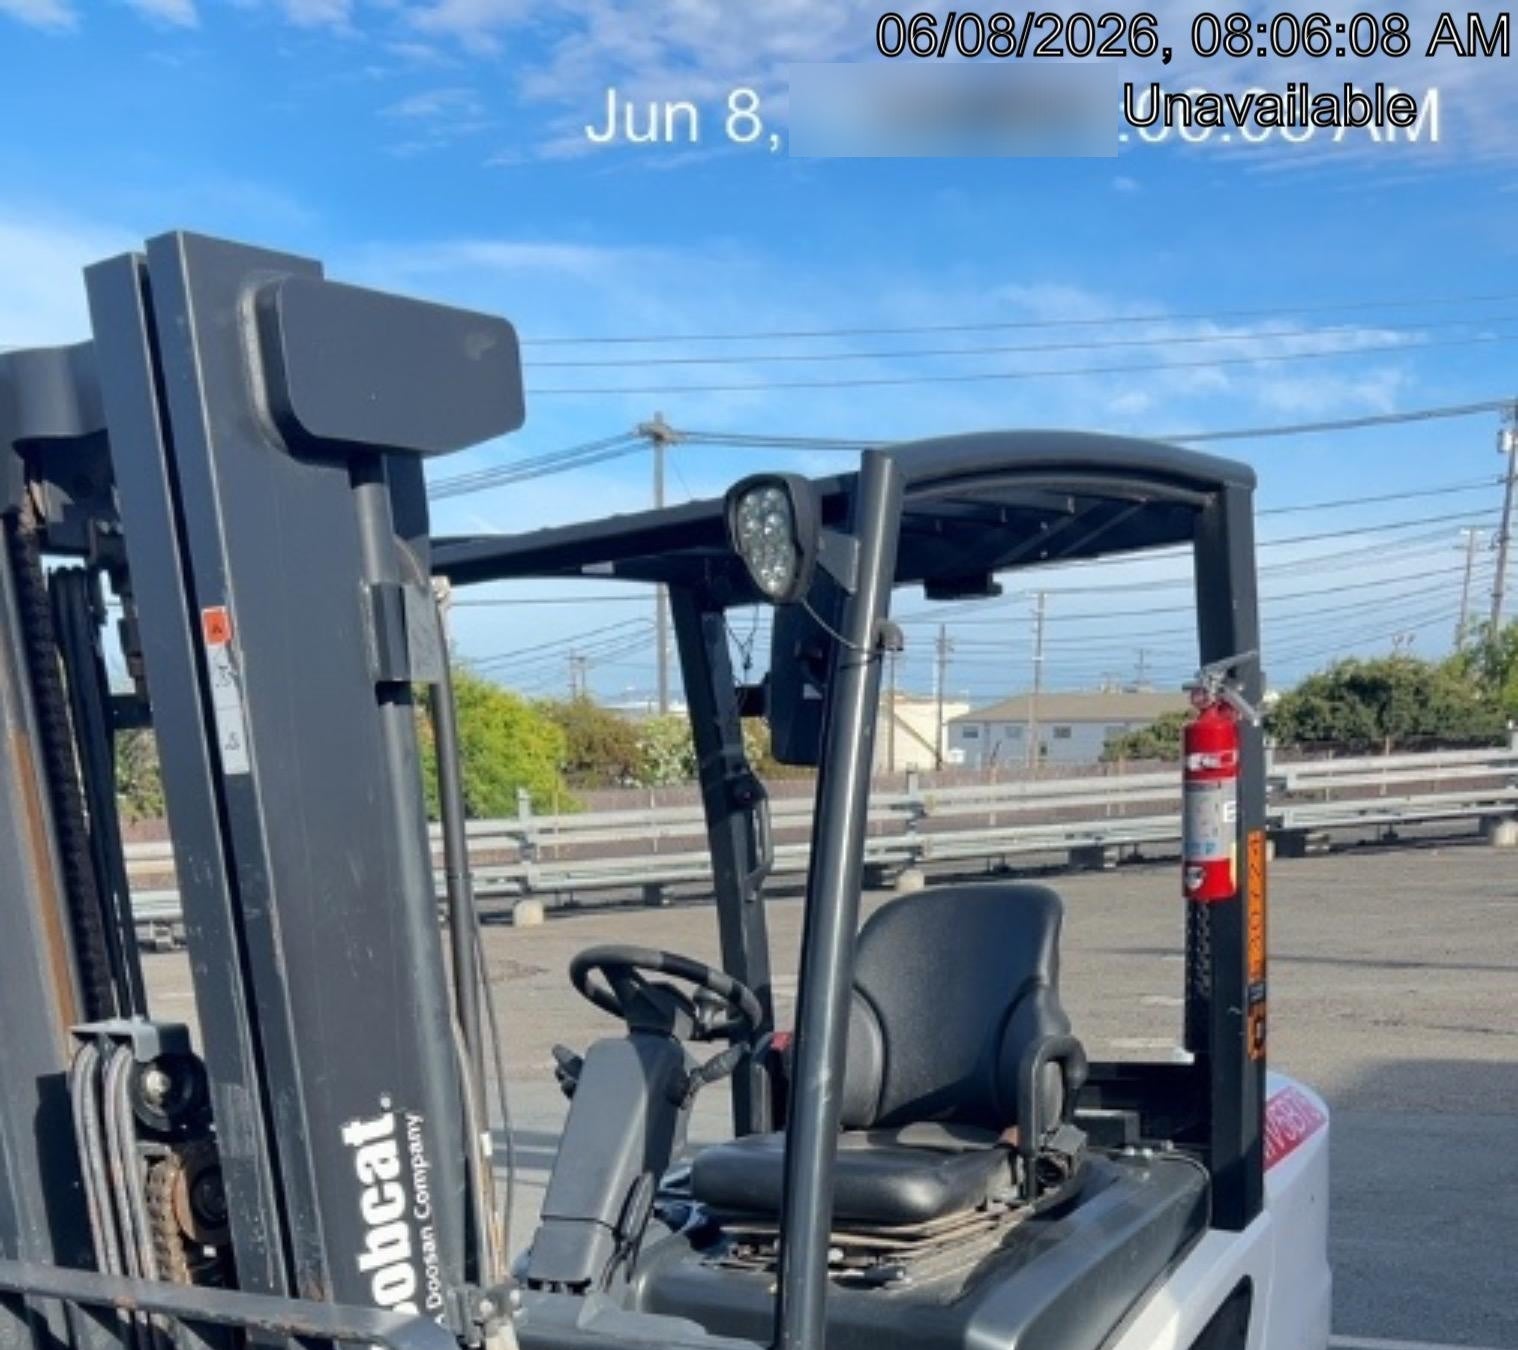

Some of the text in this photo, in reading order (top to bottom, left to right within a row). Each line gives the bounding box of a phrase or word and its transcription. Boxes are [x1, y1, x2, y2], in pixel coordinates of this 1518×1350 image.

[341, 1112, 420, 1317] obcat
[405, 1111, 432, 1220] Company
[421, 1226, 443, 1310] Doosan
